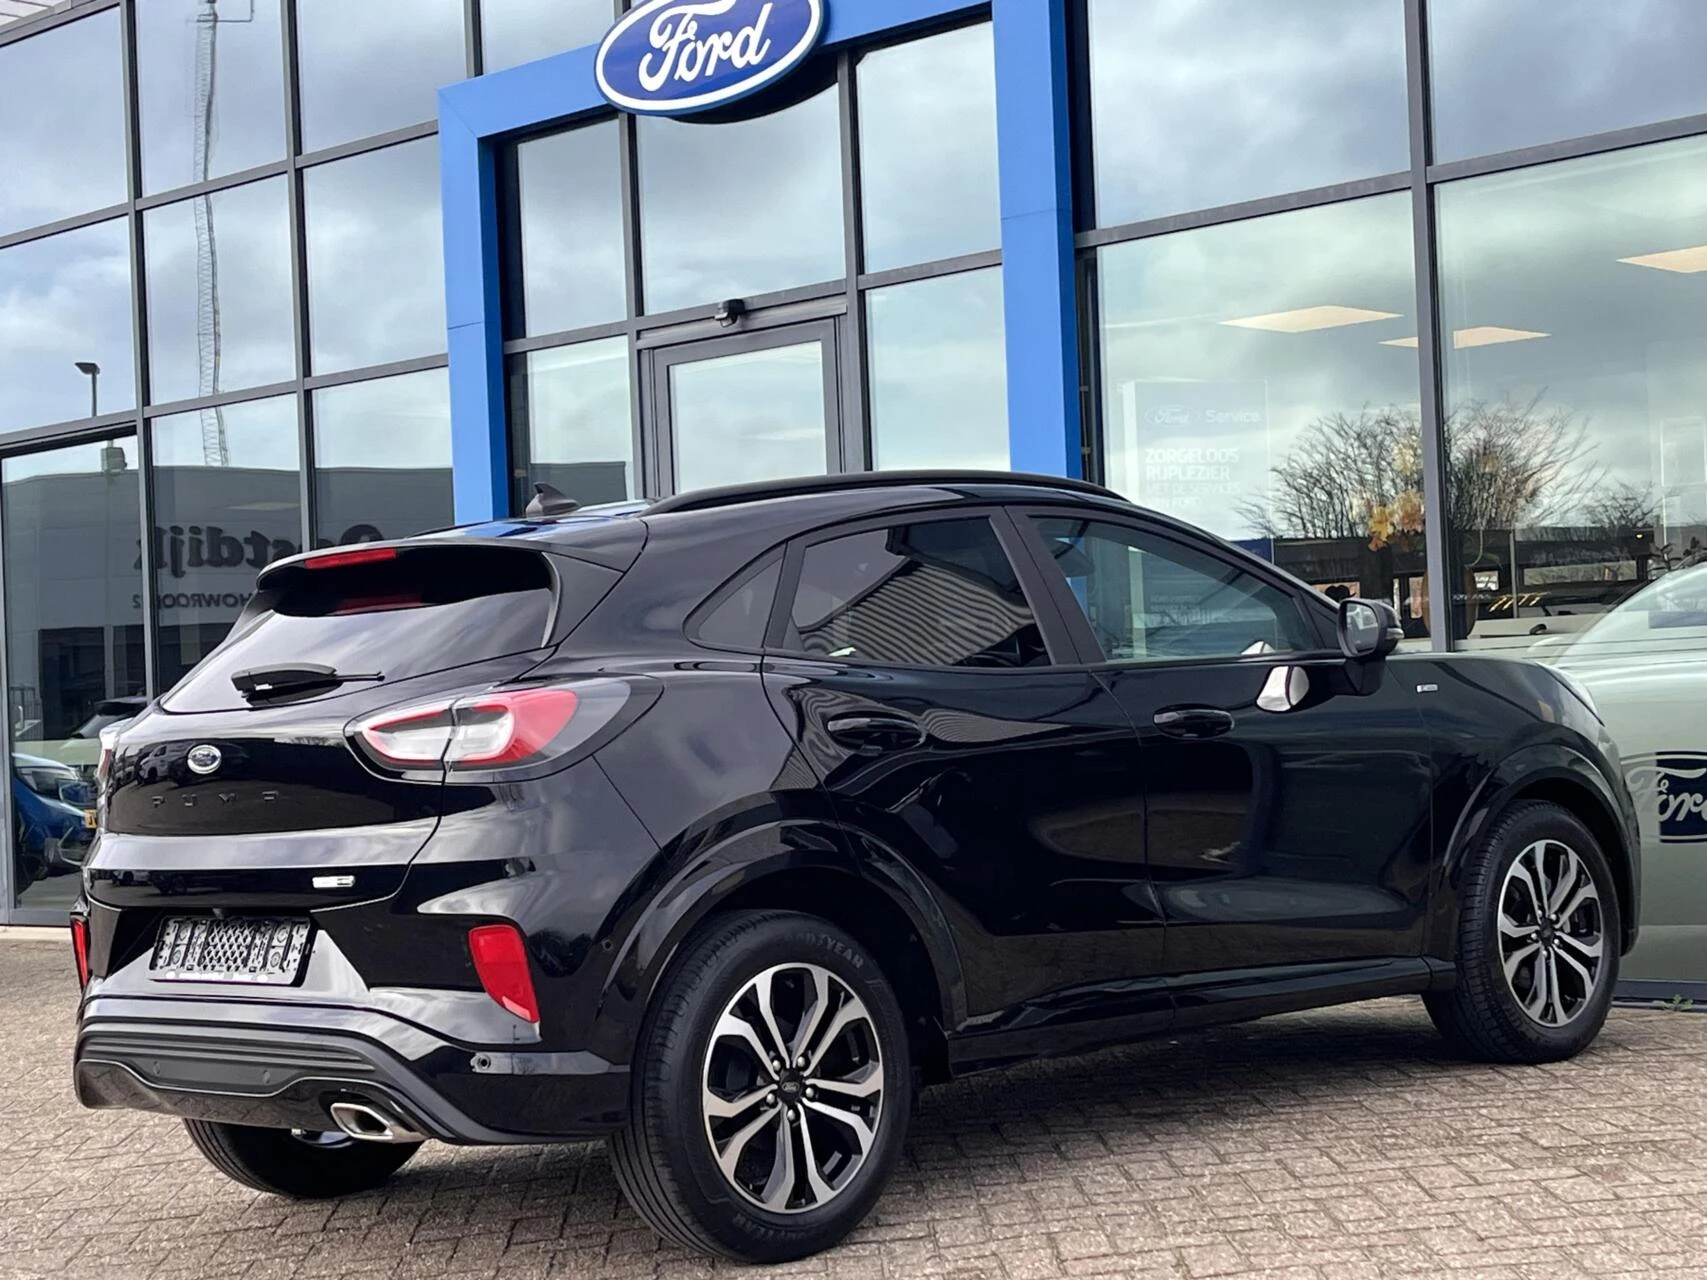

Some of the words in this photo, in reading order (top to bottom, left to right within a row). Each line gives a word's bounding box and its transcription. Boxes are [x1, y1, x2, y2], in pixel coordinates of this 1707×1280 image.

[638, 0, 774, 92] Ford
[1205, 409, 1261, 423] Service
[1145, 448, 1240, 464] ZORGELOOS
[1146, 465, 1231, 481] RIJPLEZIER
[1624, 766, 1707, 822] For
